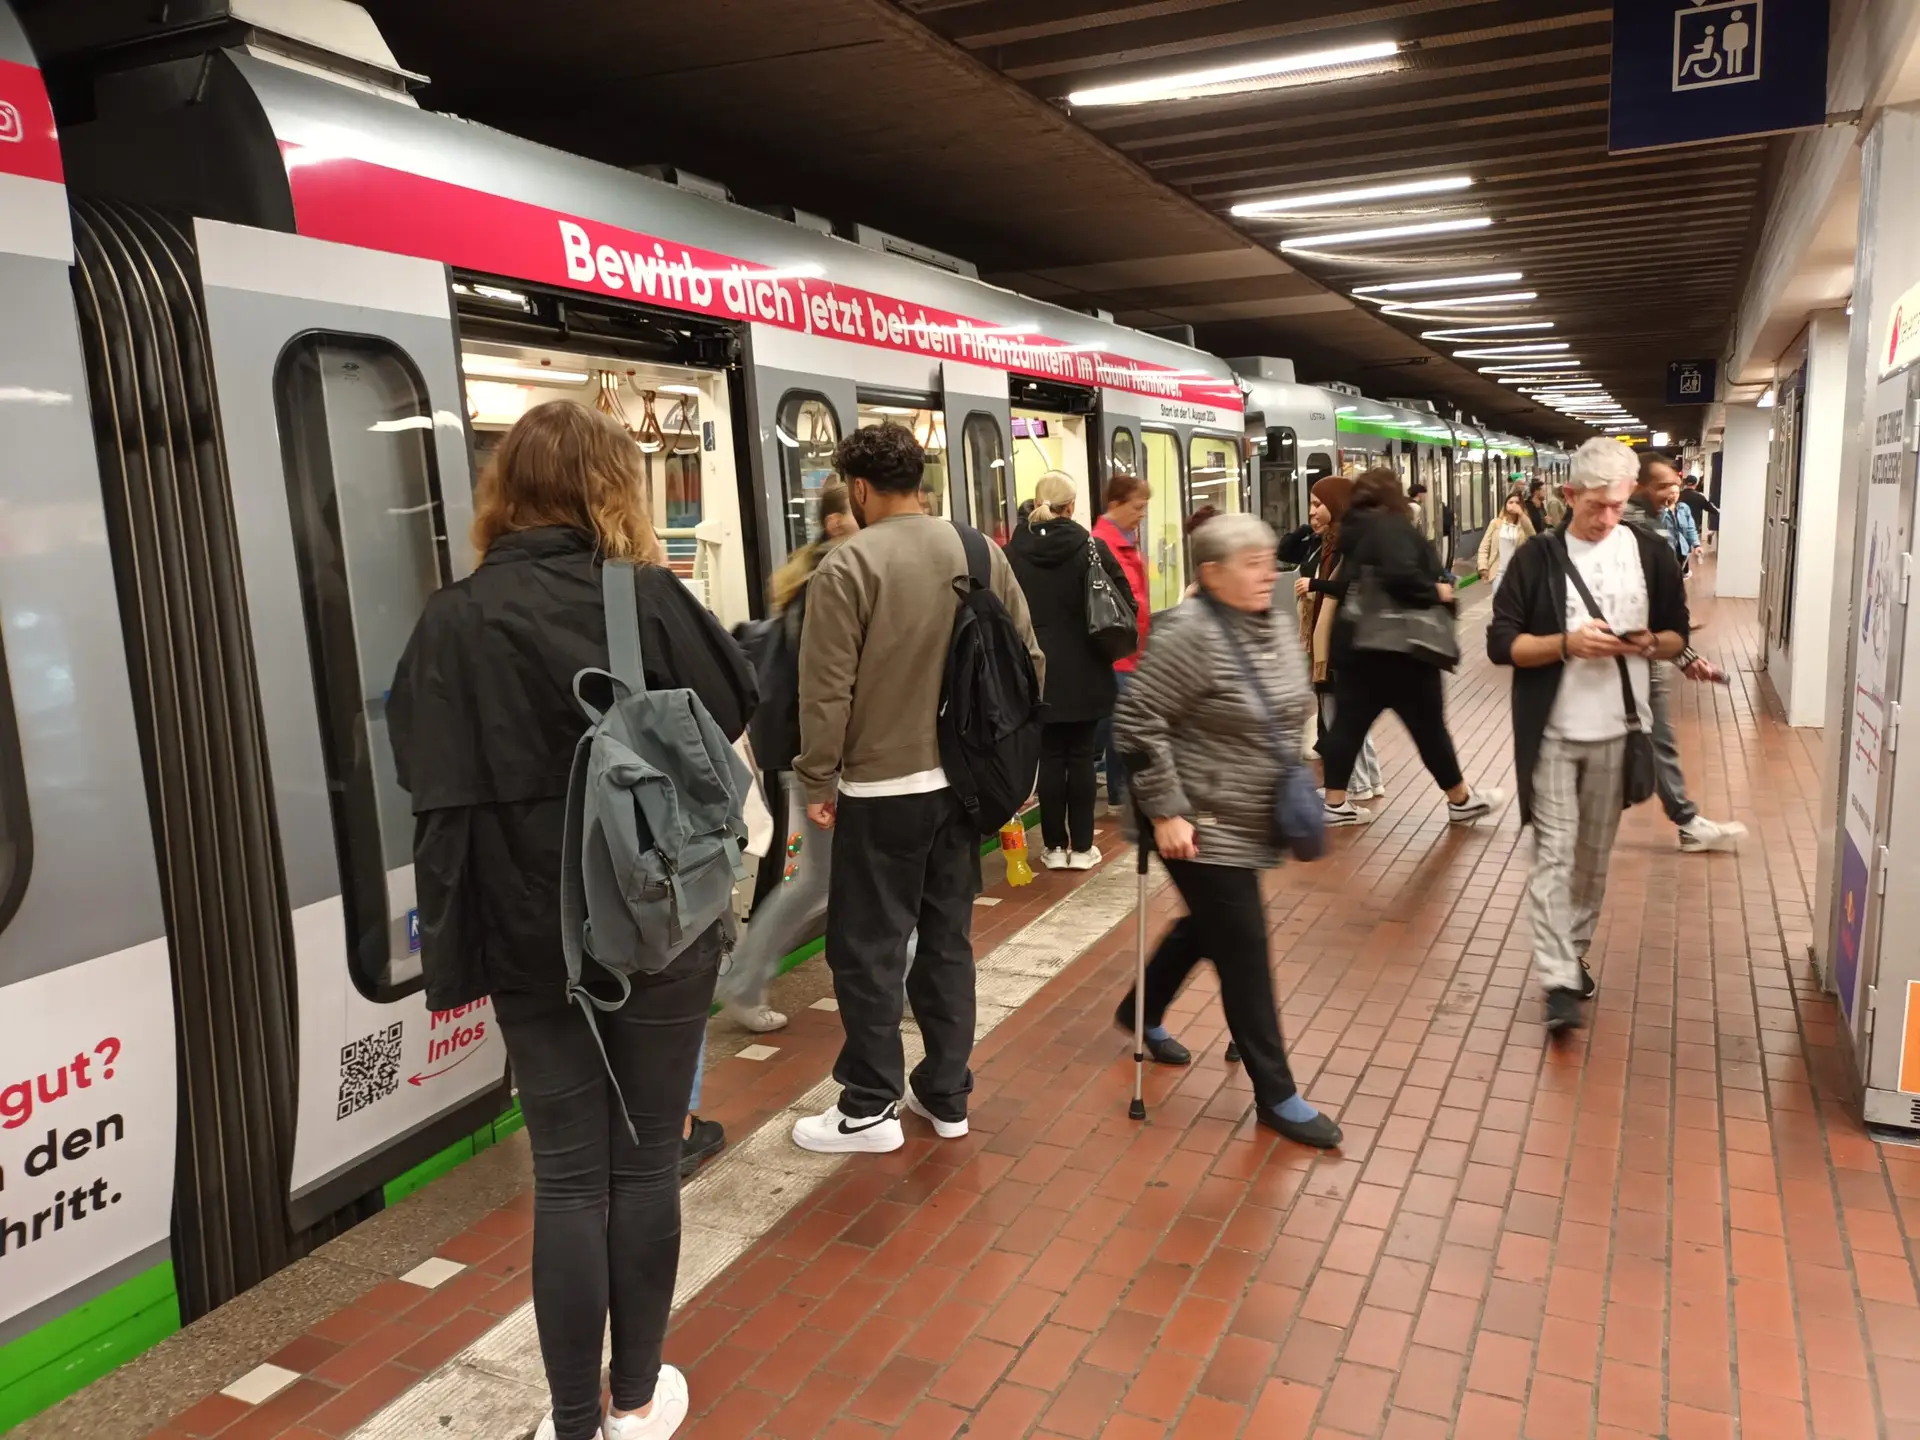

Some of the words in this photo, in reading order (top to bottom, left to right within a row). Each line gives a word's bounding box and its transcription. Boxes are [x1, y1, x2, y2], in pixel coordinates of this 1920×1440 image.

[558, 219, 713, 307] Bewirb
[722, 264, 796, 324] dich
[798, 279, 866, 335] jetzt
[866, 297, 911, 346] bei
[914, 310, 957, 355] den
[956, 318, 1074, 378] Finanzämtern
[1075, 352, 1094, 381] im
[1092, 352, 1131, 389] Raum
[1160, 403, 1173, 417] Start
[1179, 406, 1187, 419] der
[1192, 408, 1206, 424] August
[427, 1021, 485, 1065] Infos
[0, 1037, 121, 1129] gut?
[24, 1113, 124, 1177] den
